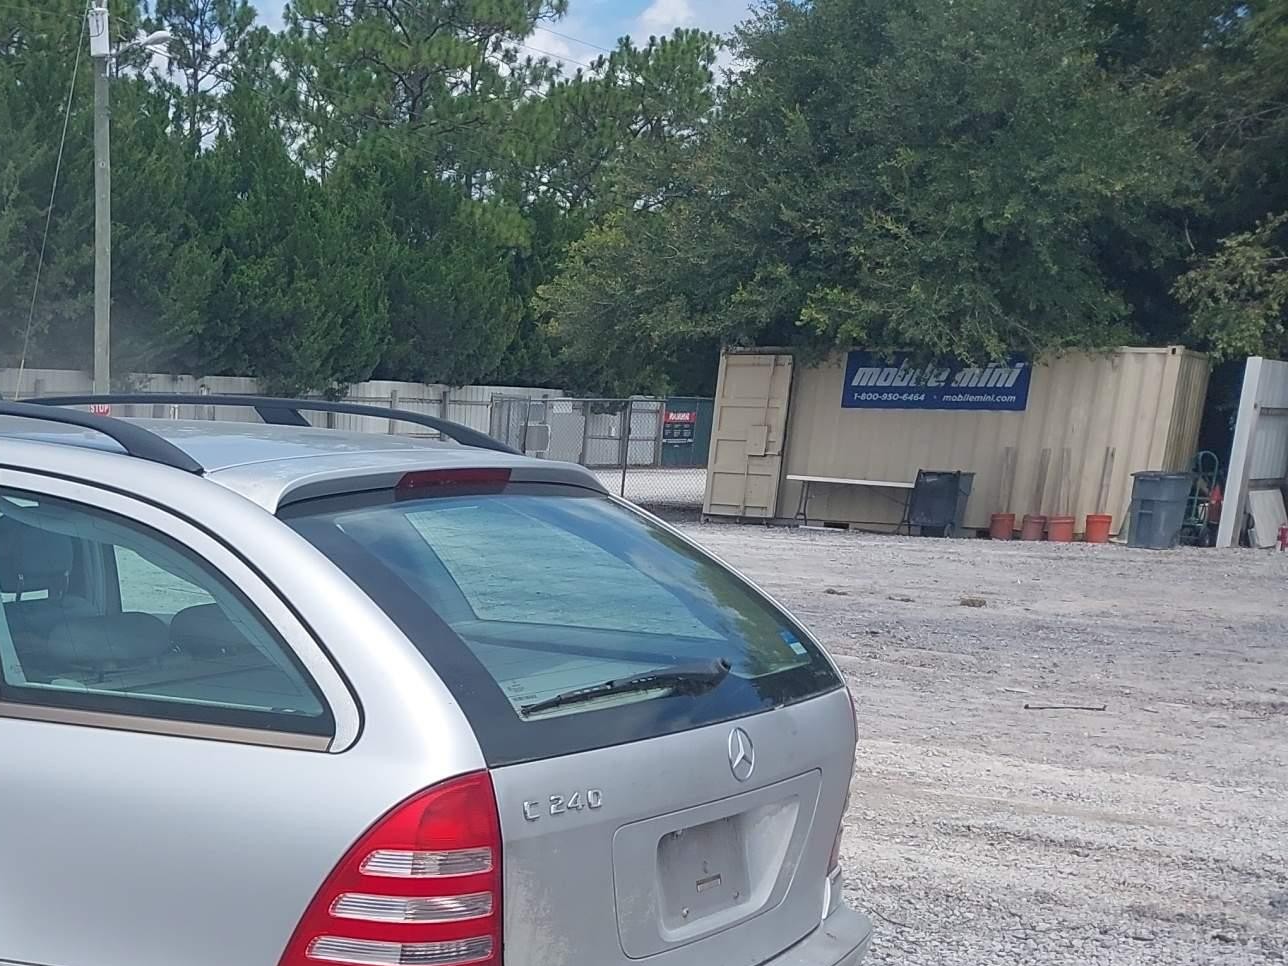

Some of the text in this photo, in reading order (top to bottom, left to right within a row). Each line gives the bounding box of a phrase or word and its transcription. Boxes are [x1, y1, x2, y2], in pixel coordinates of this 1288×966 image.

[854, 392, 1017, 403] 1-800-950-6464 mobilemini.com
[90, 403, 110, 414] STOP
[523, 789, 602, 822] C 240
